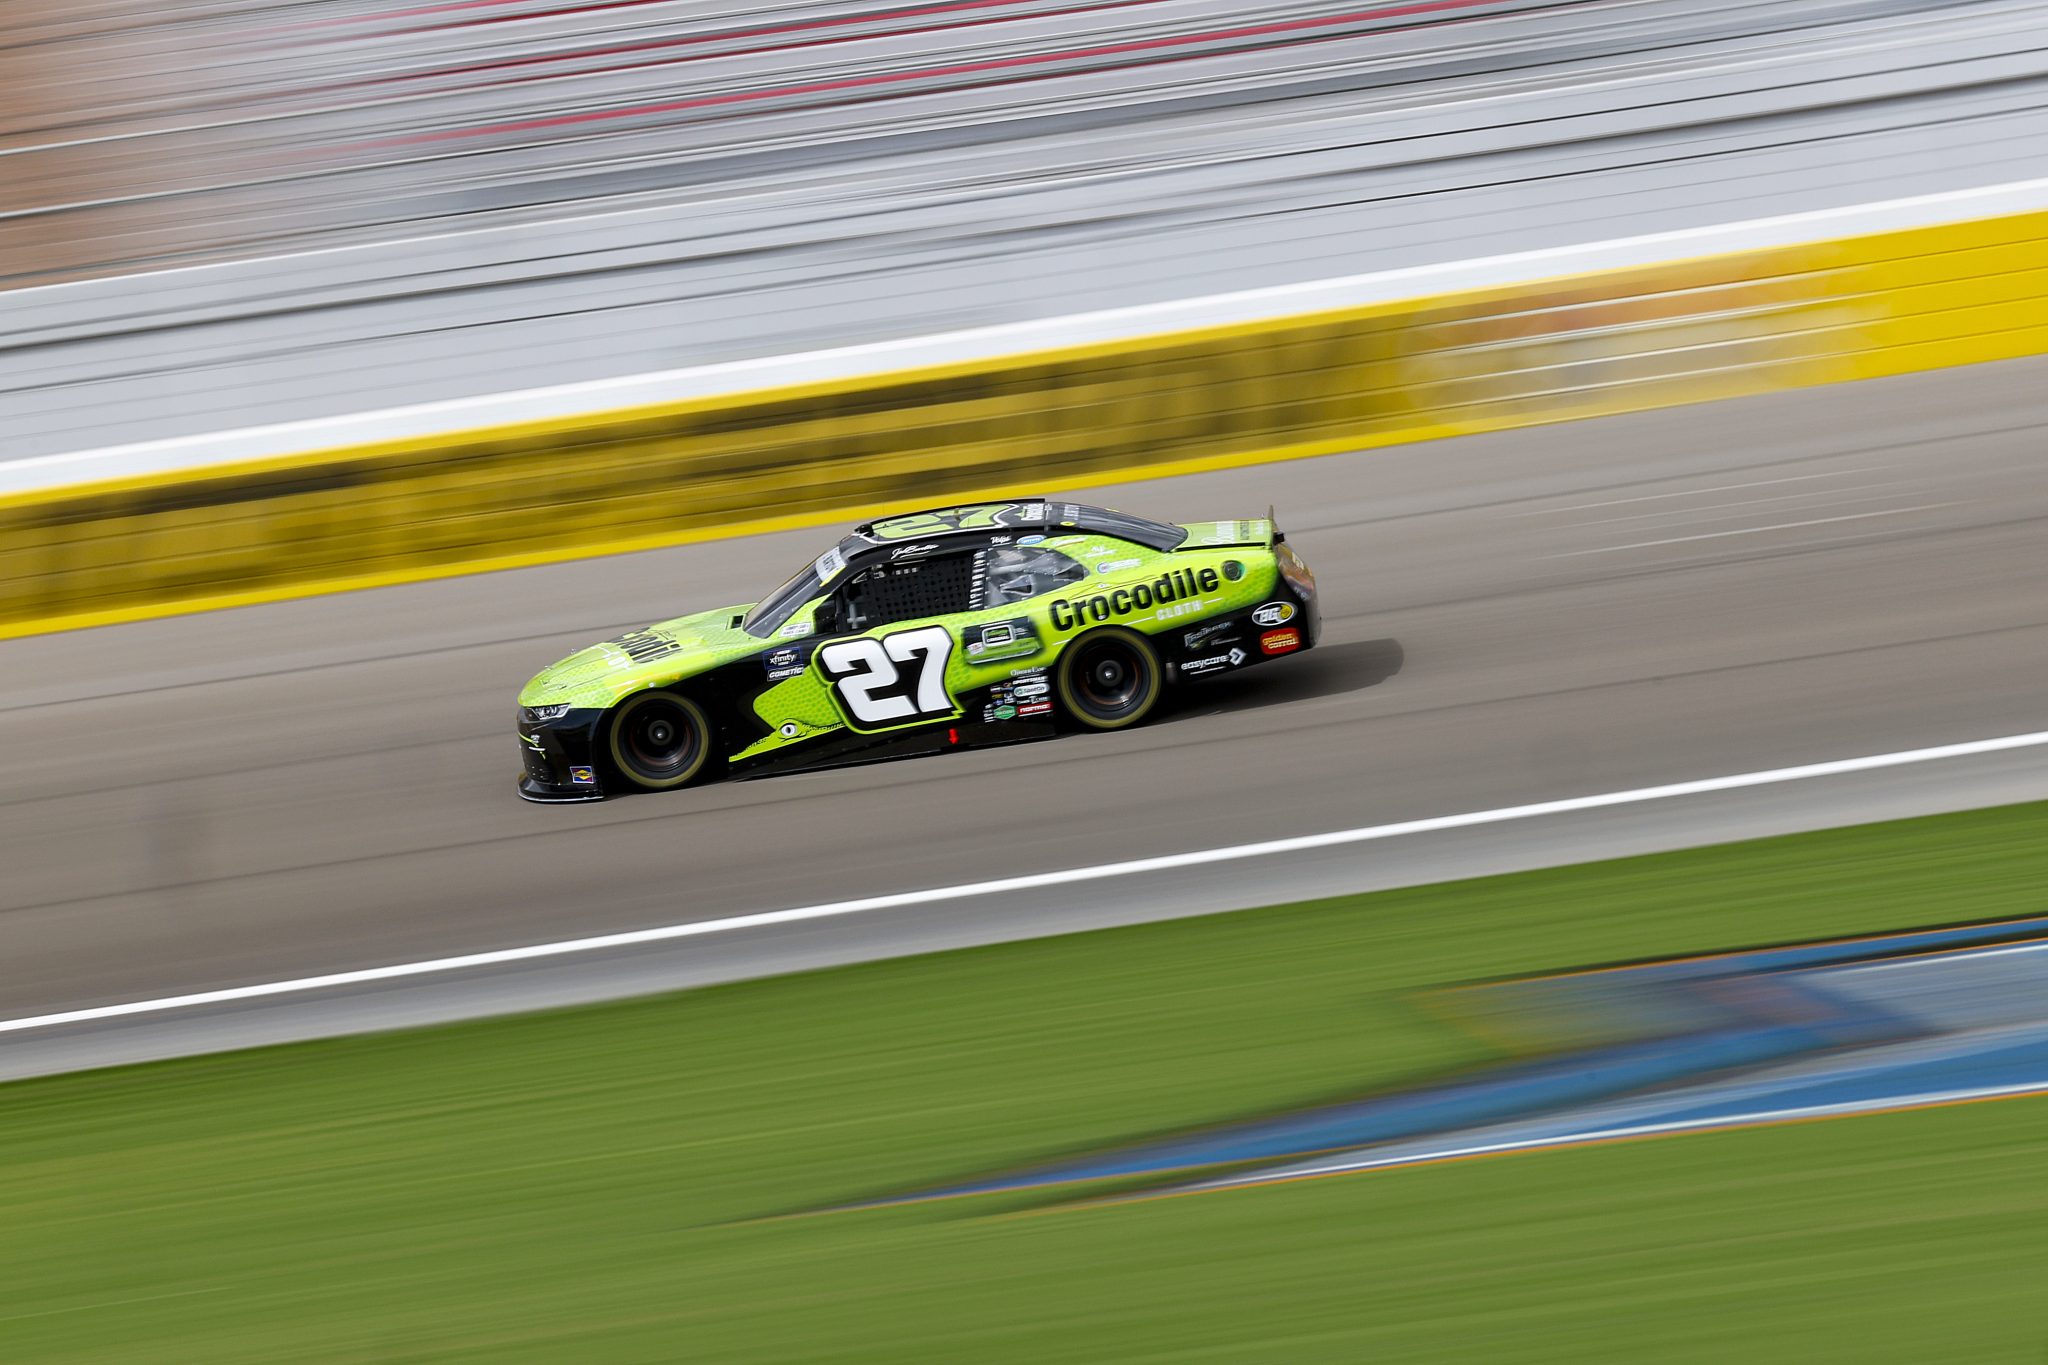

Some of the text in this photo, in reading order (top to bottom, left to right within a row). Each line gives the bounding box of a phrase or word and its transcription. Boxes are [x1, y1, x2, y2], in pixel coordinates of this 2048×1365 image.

[1049, 567, 1219, 631] Crocodile
[1156, 601, 1203, 620] CLOTH
[1263, 633, 1296, 646] golden
[1268, 638, 1299, 649] corral
[770, 653, 797, 665] xfinity
[1181, 655, 1230, 670] easycare
[821, 626, 954, 722] 27
